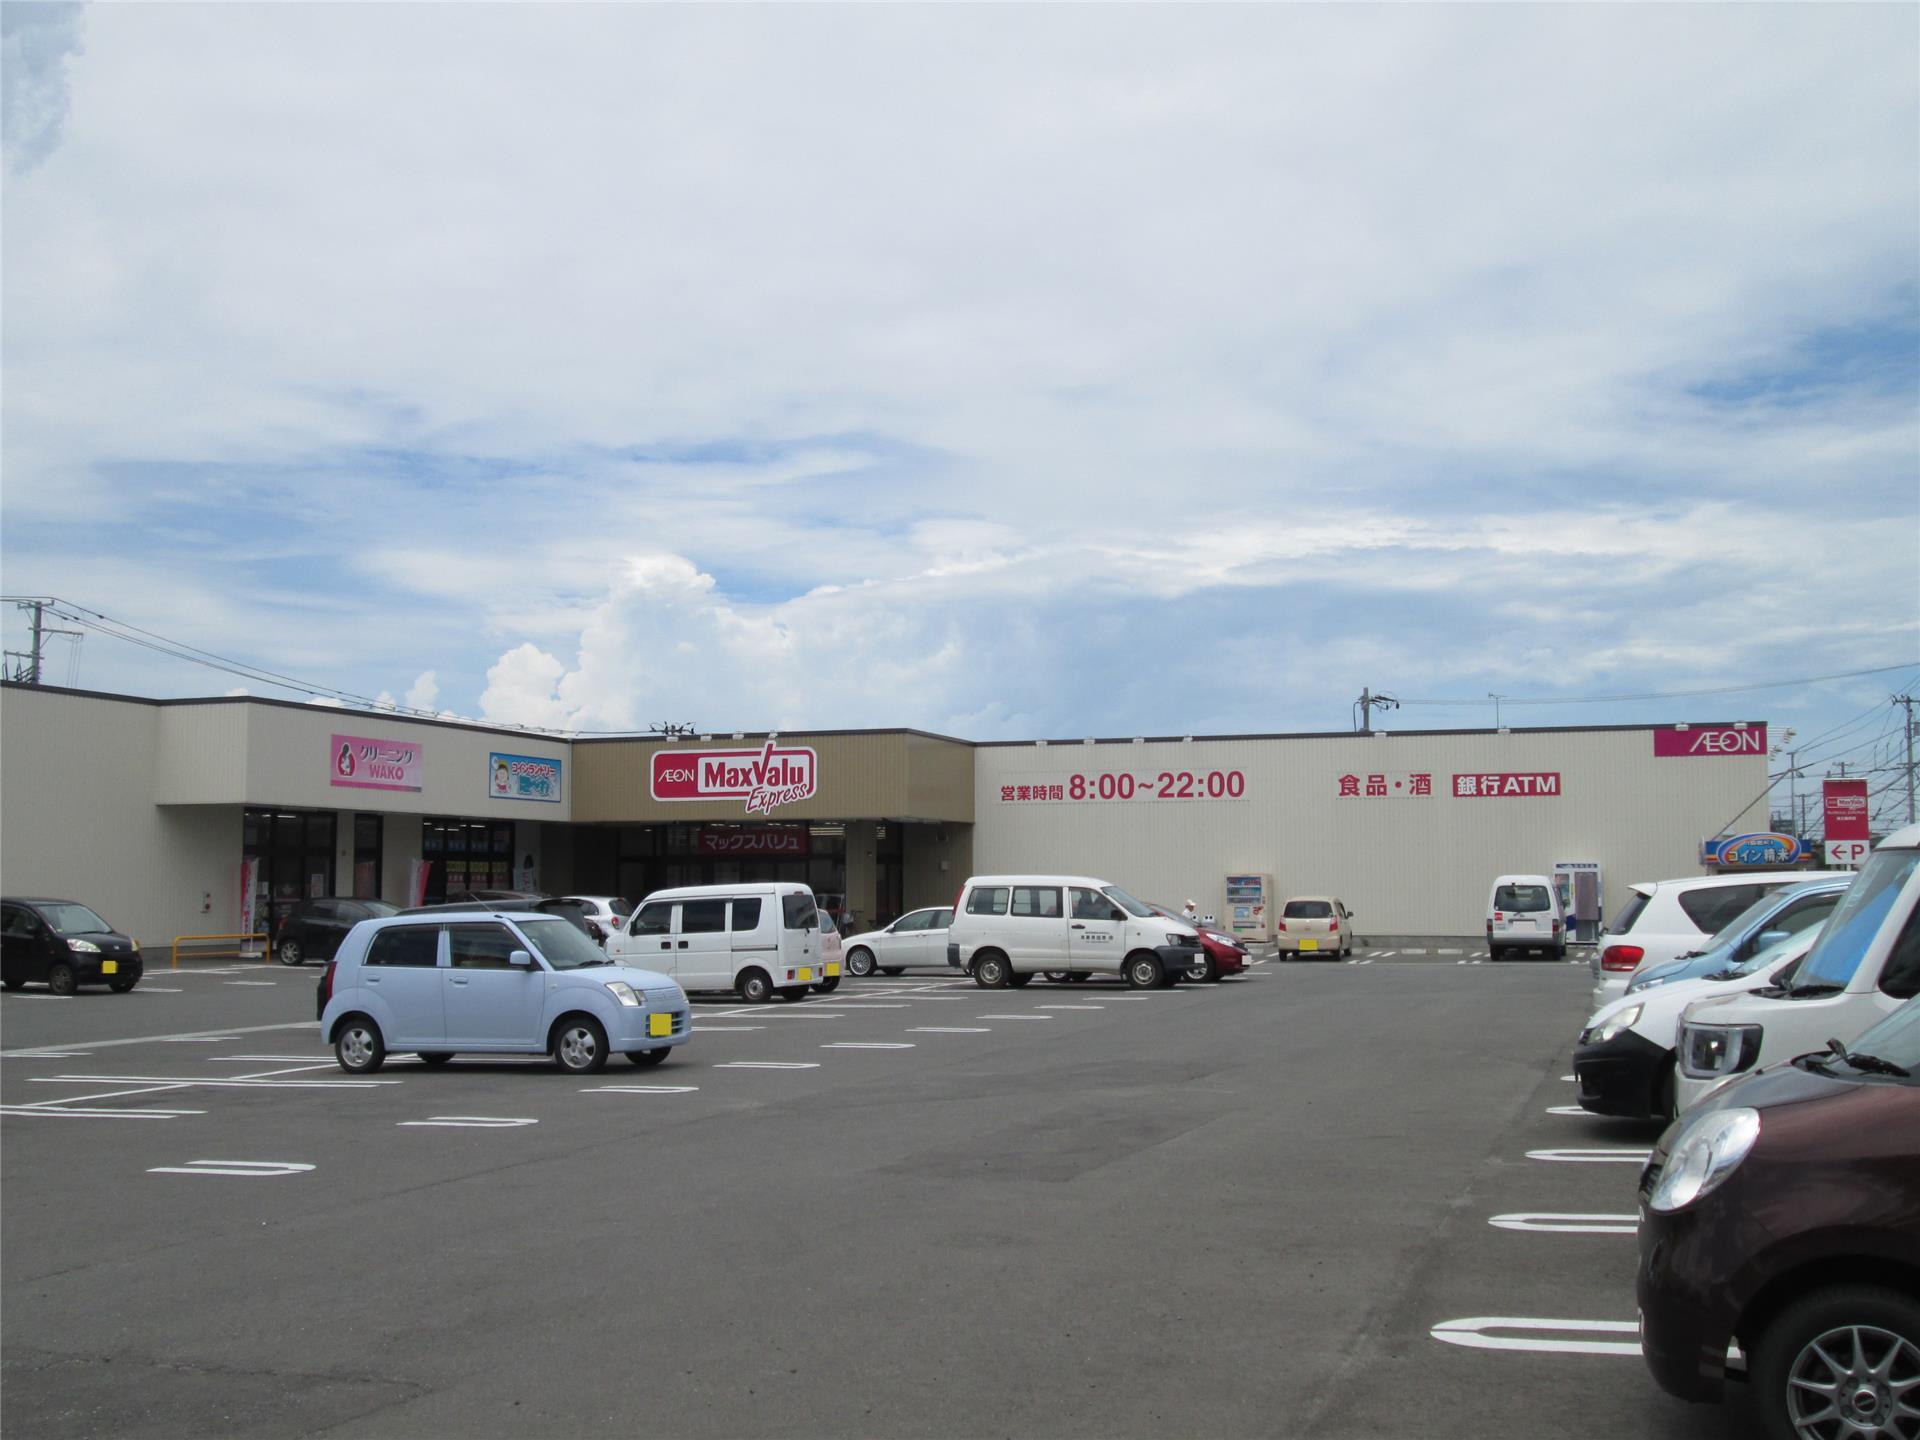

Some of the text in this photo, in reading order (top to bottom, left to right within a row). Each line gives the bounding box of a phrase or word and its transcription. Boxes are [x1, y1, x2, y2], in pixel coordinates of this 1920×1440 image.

[360, 745, 414, 764] クリーニング
[369, 764, 404, 780] WAKO
[704, 743, 804, 787] MaxValu
[1001, 785, 1063, 800] 営業時間
[1457, 776, 1556, 795] 銀行ATM
[746, 783, 807, 813] Express
[705, 834, 799, 850] マックスバリュ
[1728, 848, 1789, 862] コイン精米
[1851, 844, 1865, 860] P
